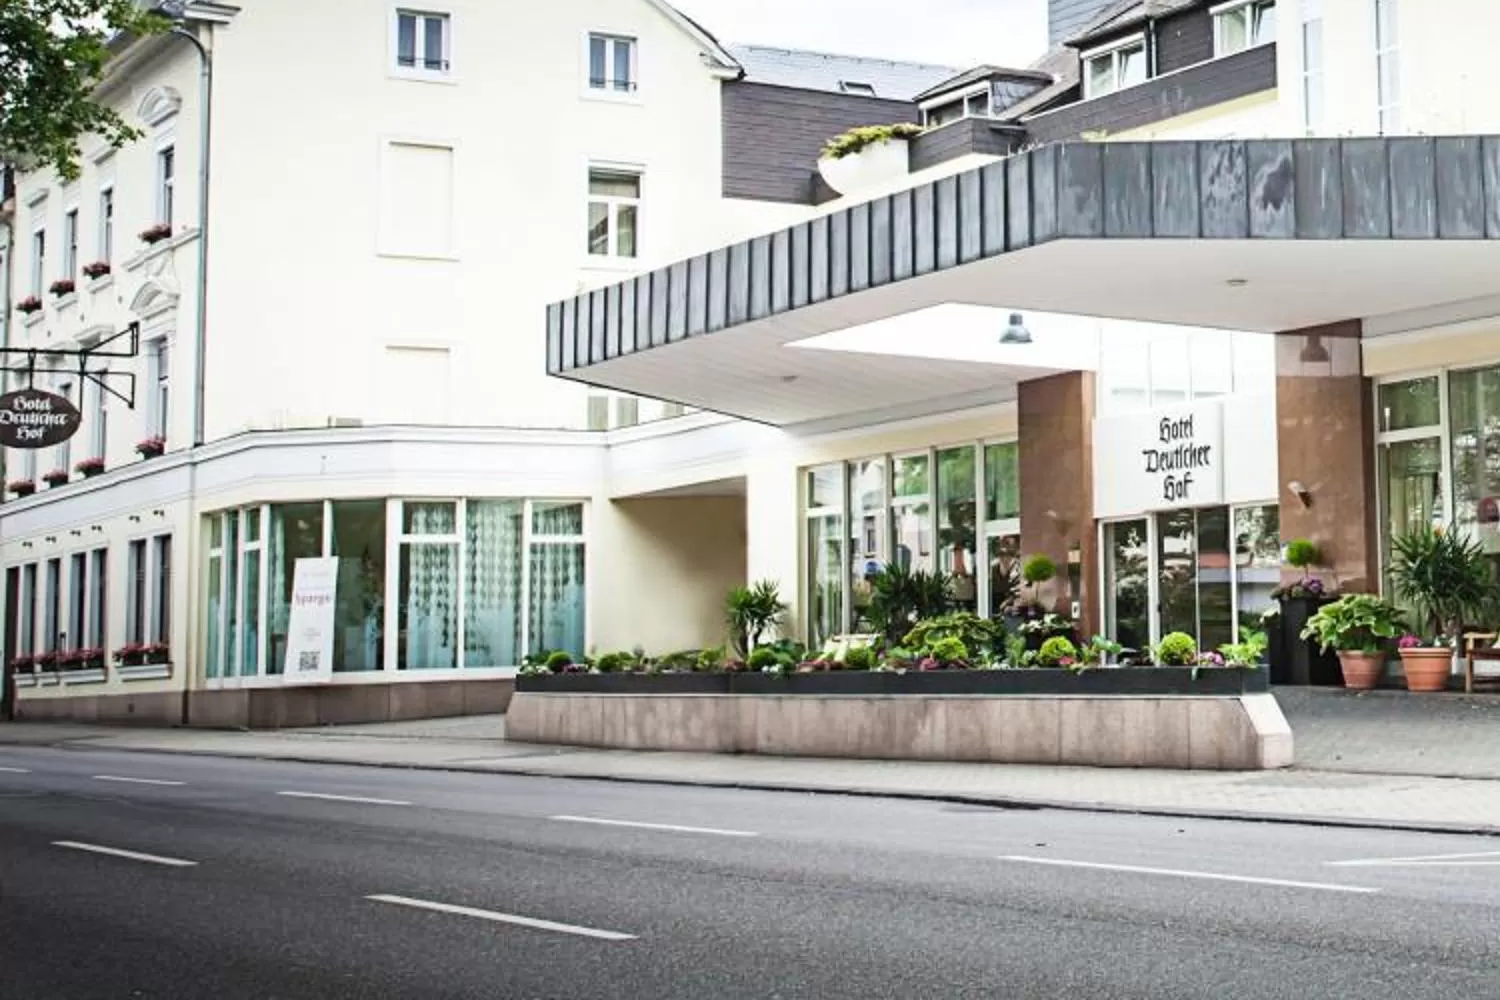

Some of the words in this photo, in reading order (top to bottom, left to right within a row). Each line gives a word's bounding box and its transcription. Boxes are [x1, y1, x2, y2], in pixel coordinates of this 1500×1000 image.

[13, 395, 52, 410] Hotel
[16, 425, 45, 440] Hof
[1159, 413, 1194, 443] Hotel
[1163, 471, 1195, 501] Hof
